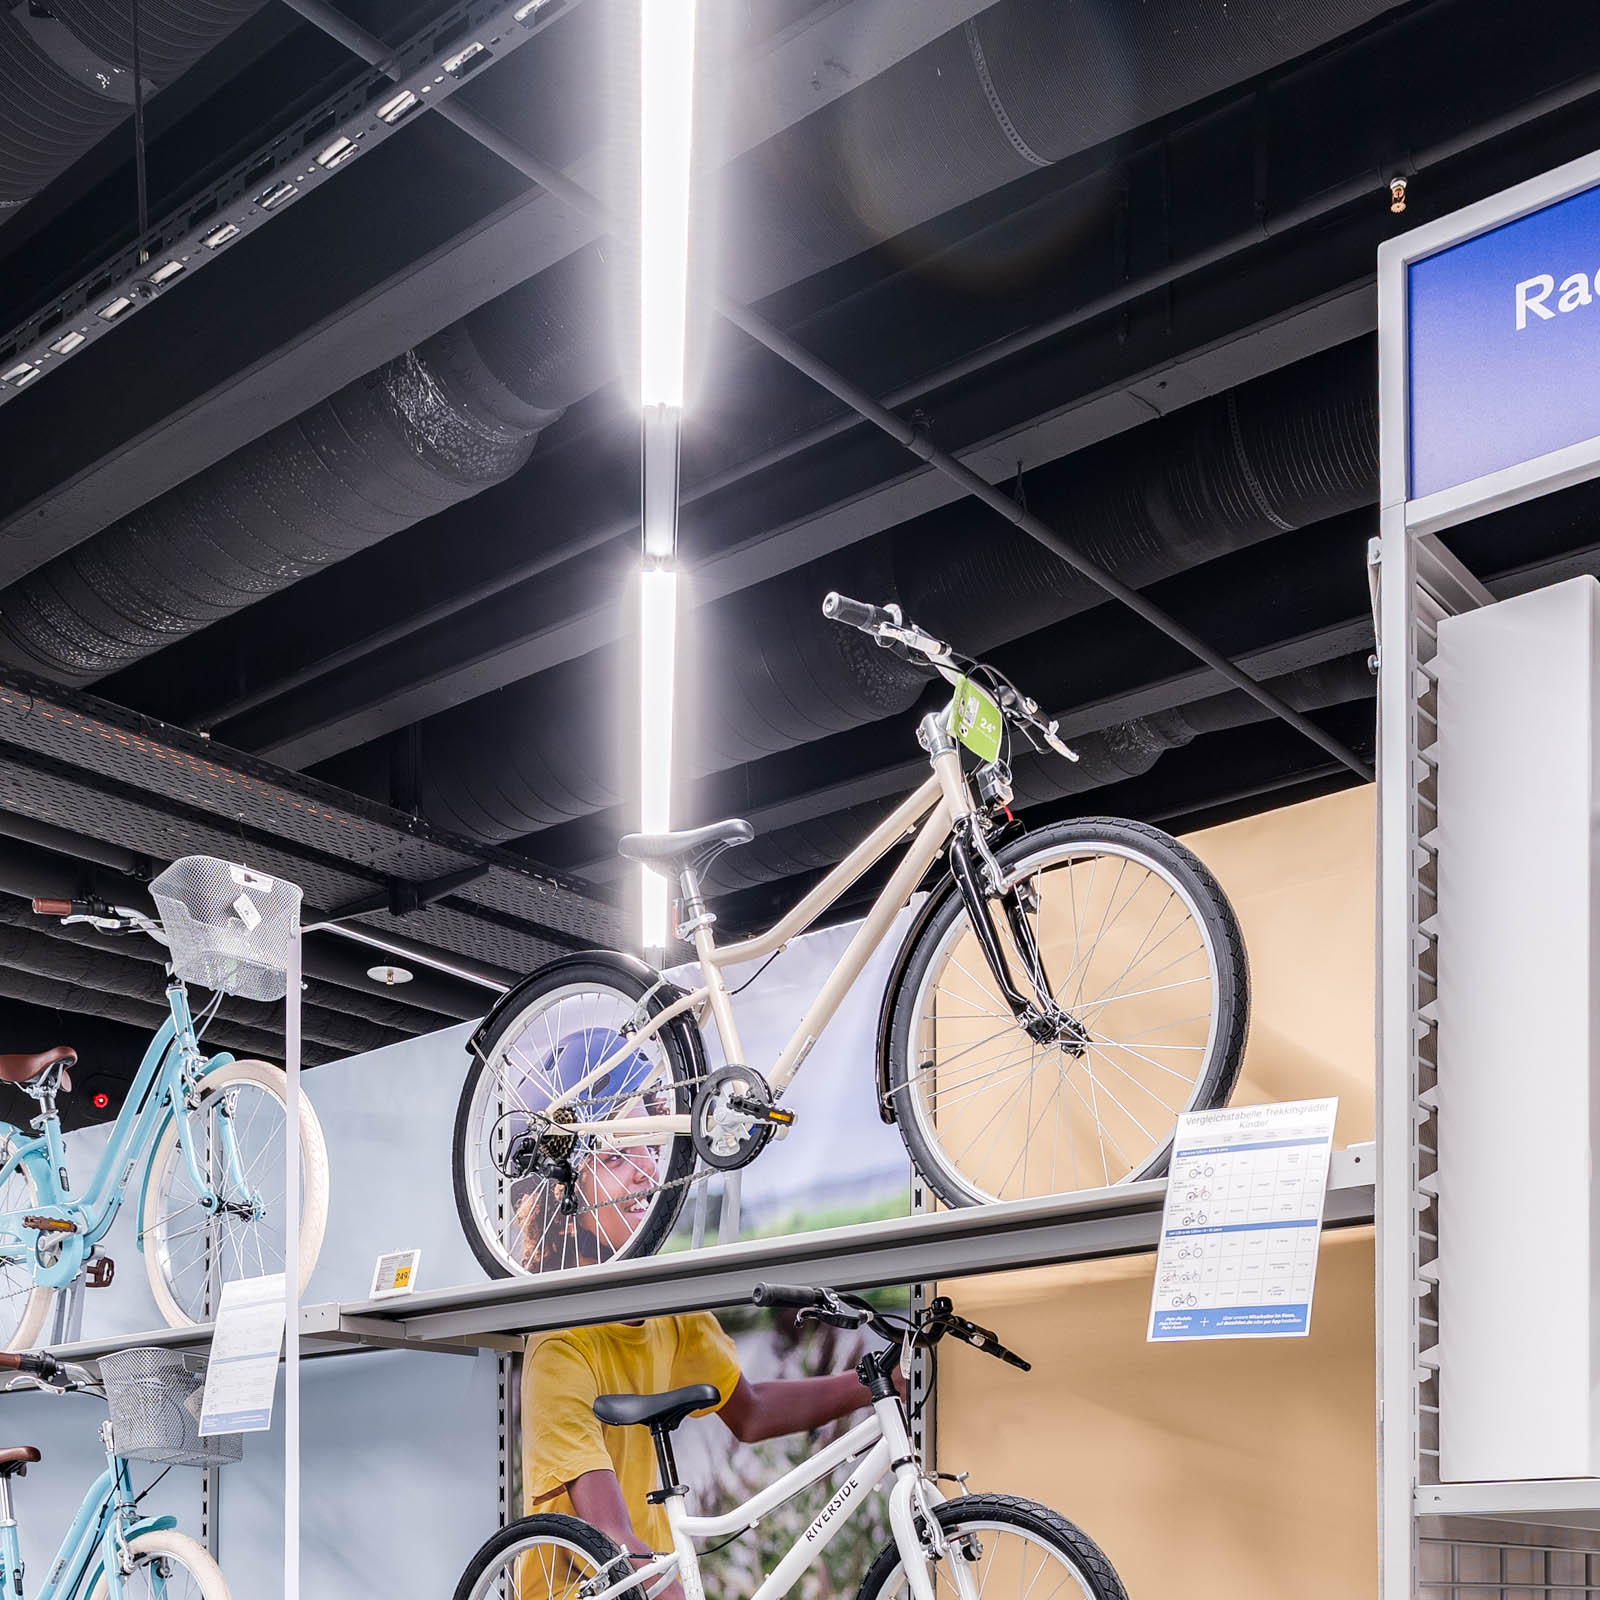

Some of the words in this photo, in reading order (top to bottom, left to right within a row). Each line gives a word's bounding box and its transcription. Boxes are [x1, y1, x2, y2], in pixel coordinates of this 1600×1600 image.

[1186, 1111, 1262, 1126] Vergleichstabelle
[1266, 1104, 1329, 1118] Trekkingräder
[1239, 1120, 1269, 1128] Kinder
[805, 1479, 858, 1541] RIVERSIDE
